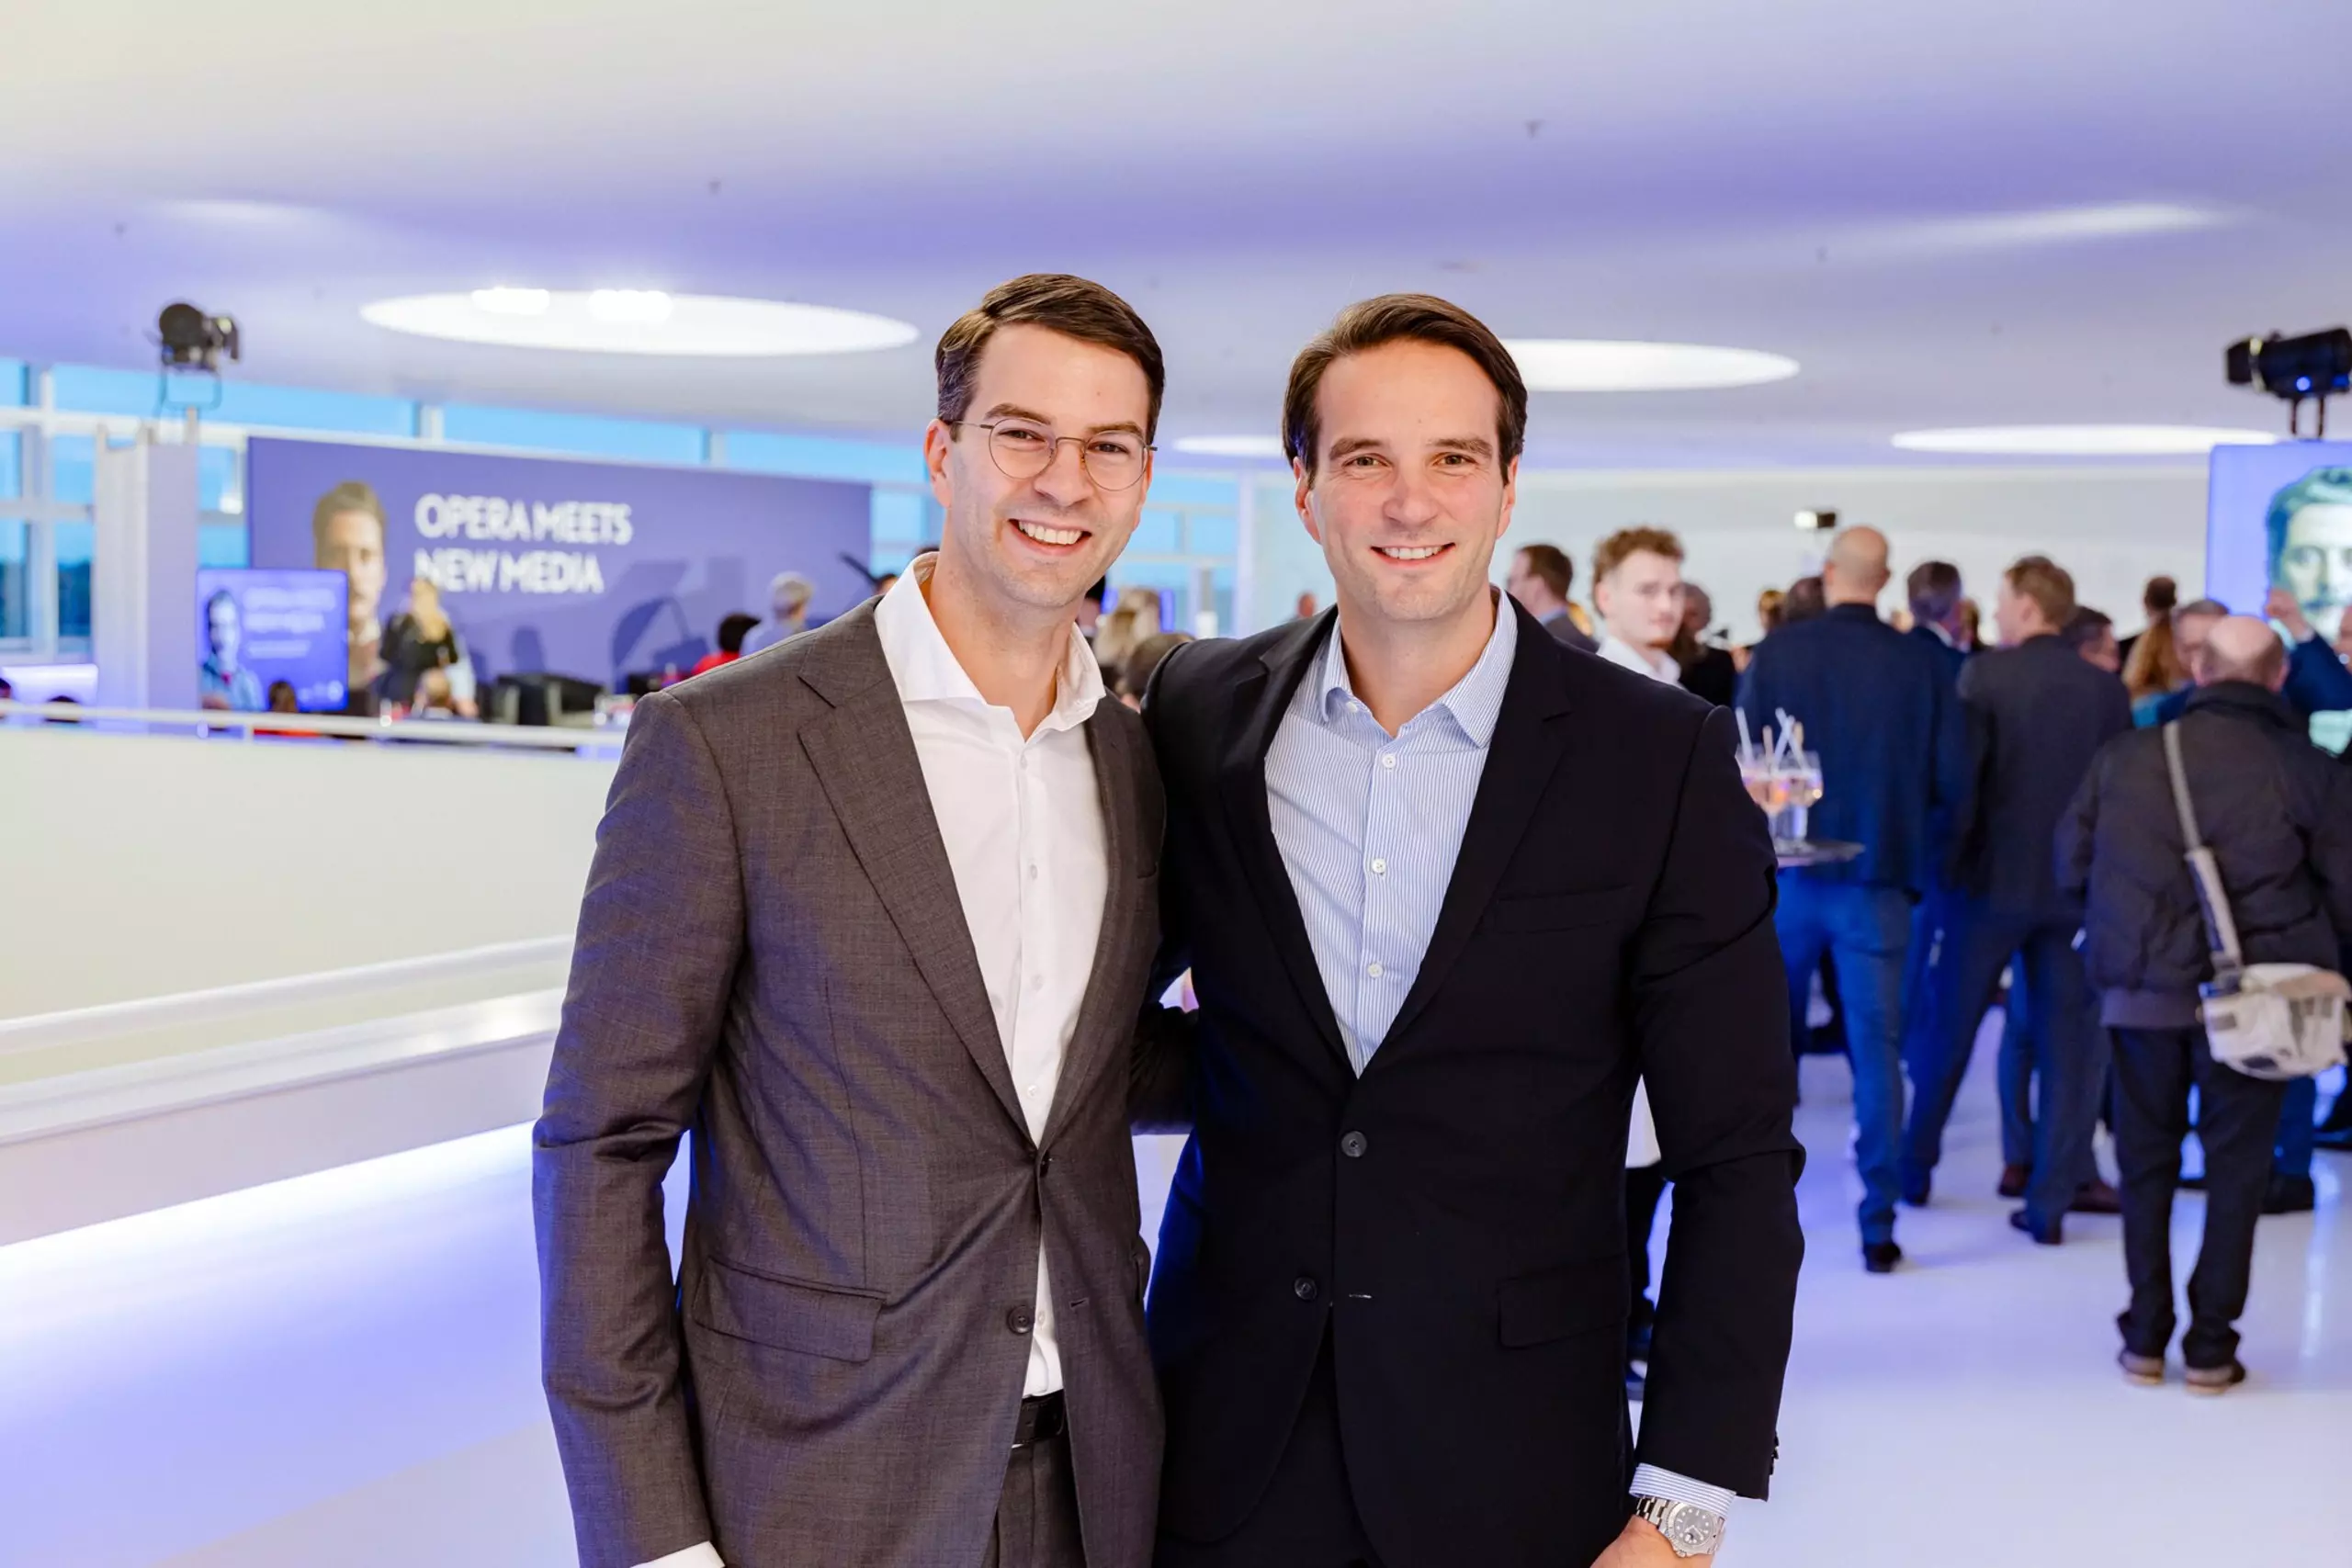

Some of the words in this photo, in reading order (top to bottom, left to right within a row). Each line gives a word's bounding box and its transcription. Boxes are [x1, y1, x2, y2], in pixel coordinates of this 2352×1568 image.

[415, 493, 531, 541] OPERA
[532, 501, 632, 545] MEETS
[414, 548, 497, 592] NEW
[499, 551, 605, 593] MEDIA
